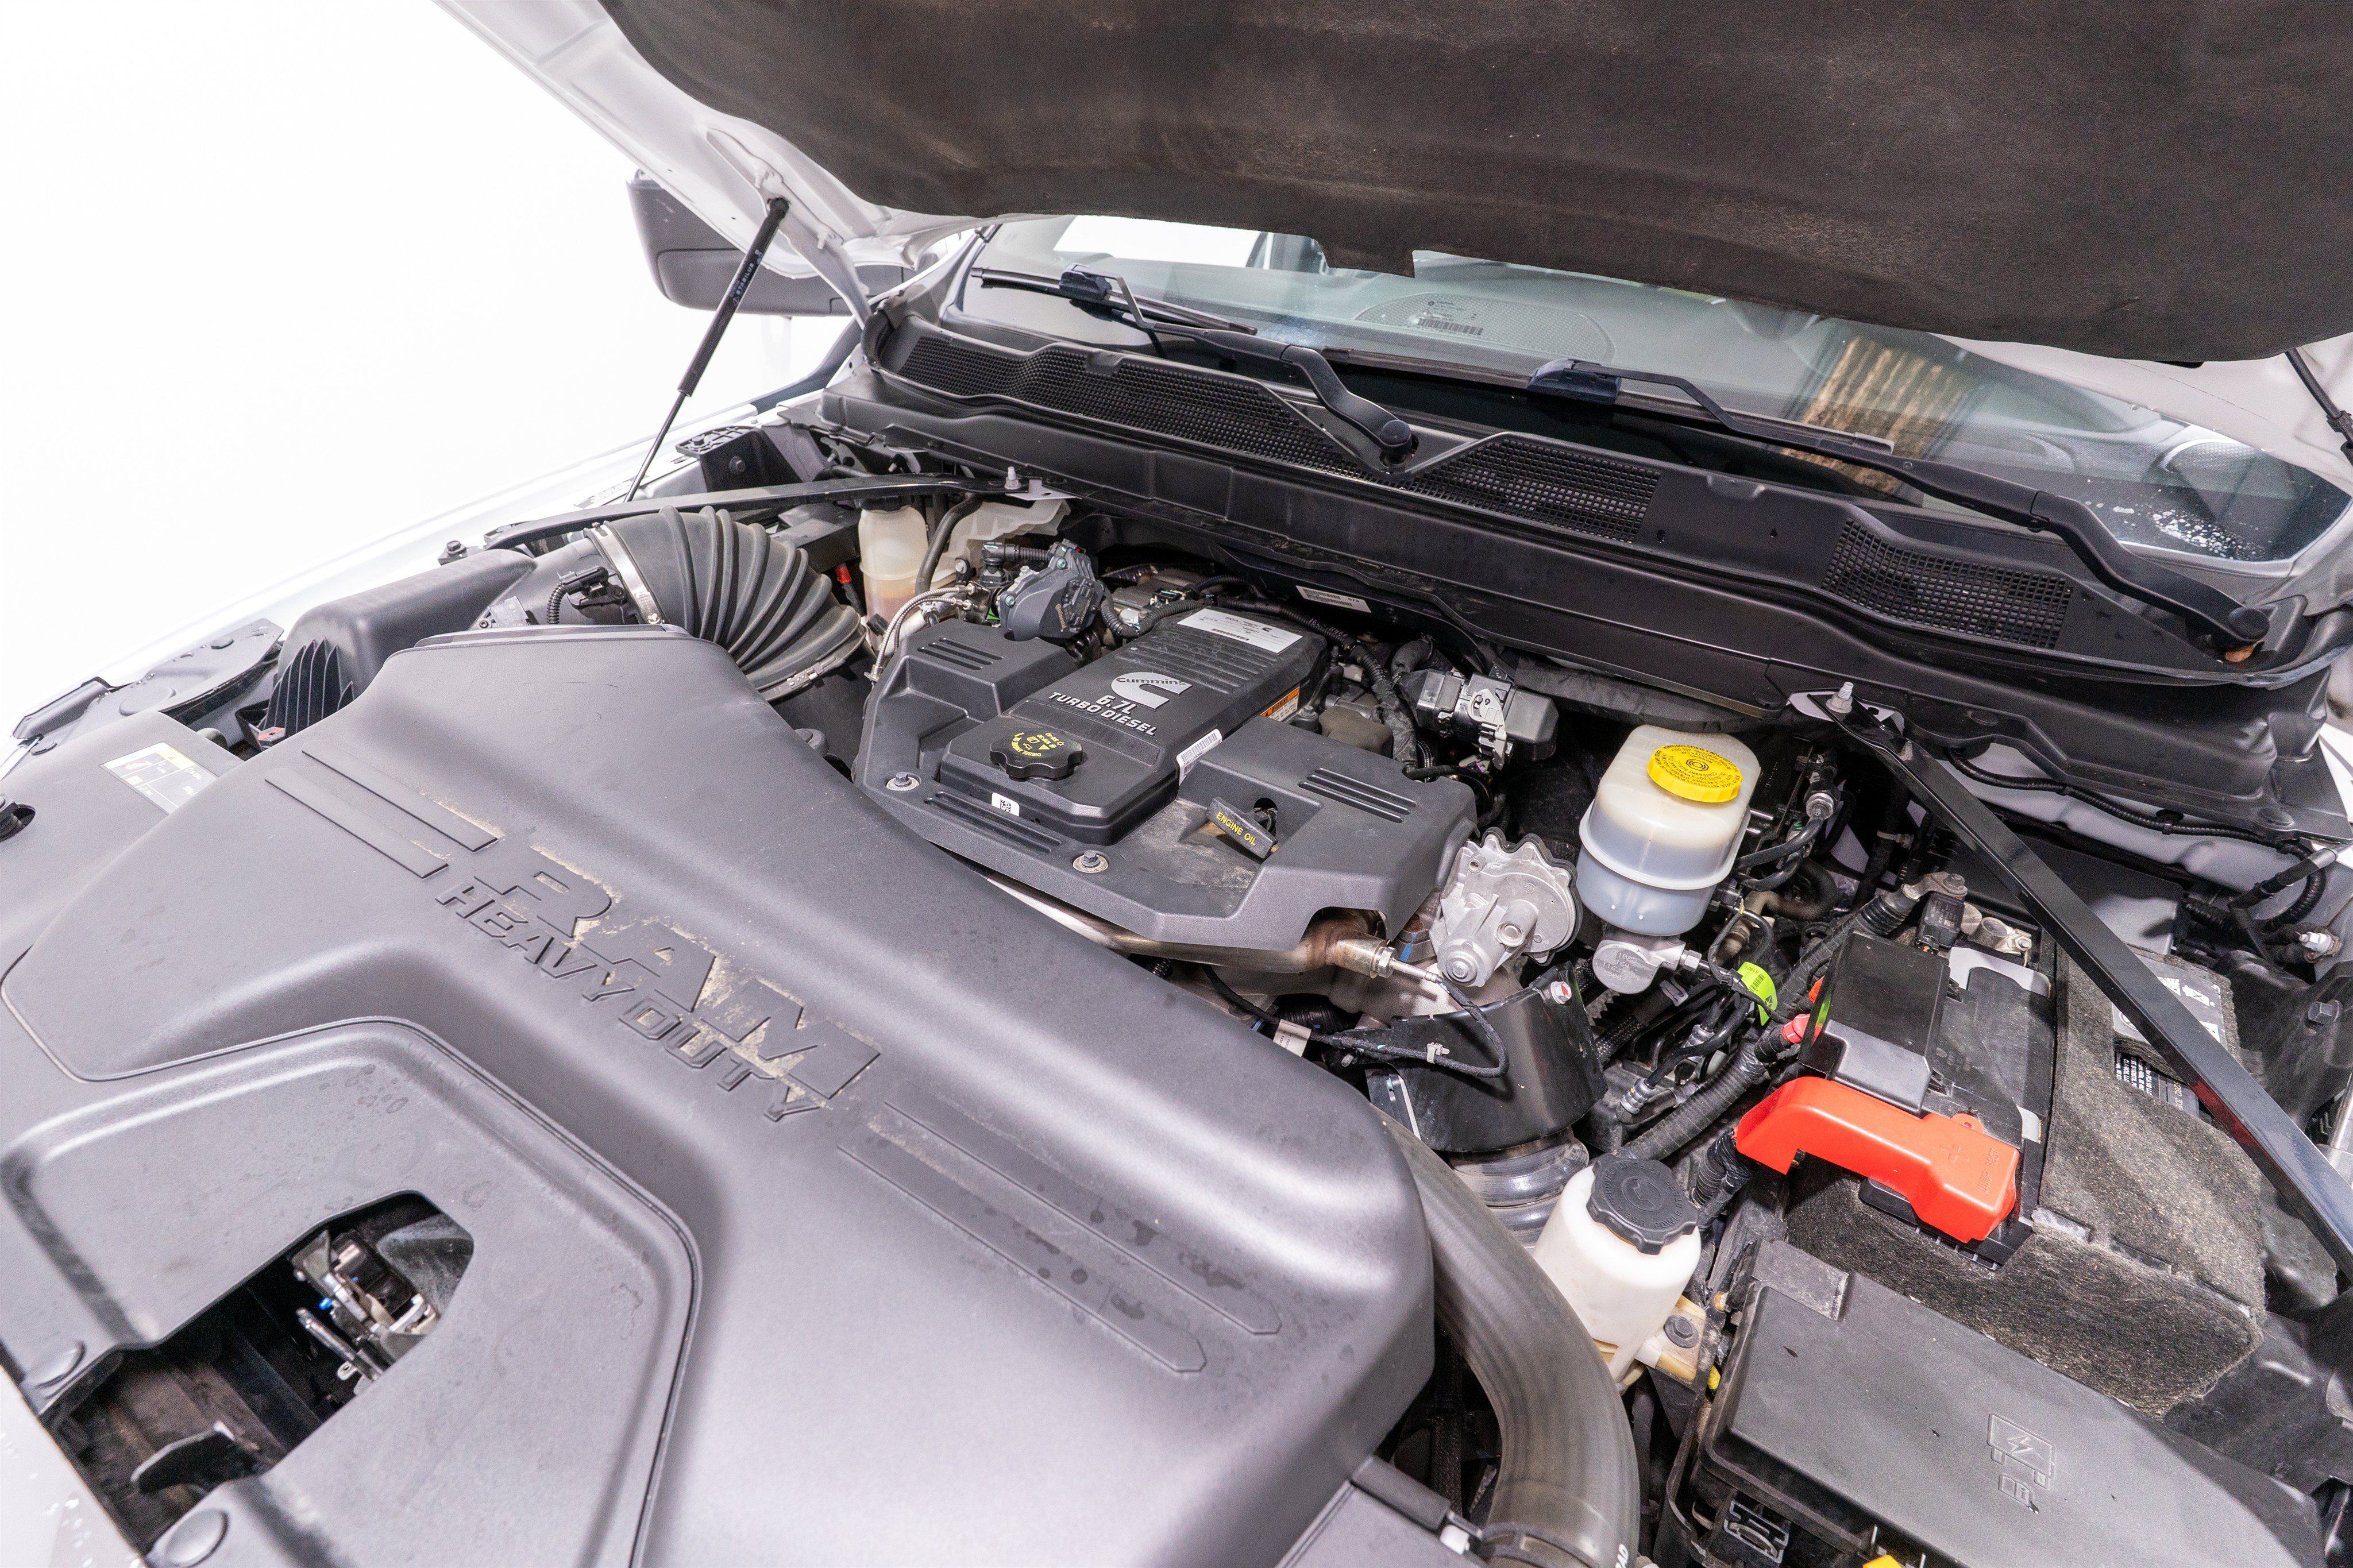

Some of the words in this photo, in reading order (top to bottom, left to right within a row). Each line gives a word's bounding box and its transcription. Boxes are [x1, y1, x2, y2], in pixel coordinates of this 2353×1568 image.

[1116, 677, 1186, 686] Cummins
[1048, 692, 1102, 713] TURBO
[1100, 709, 1158, 736] DIESEL
[1096, 694, 1137, 715] 6.7L
[1216, 812, 1244, 836] ENGINE
[1244, 833, 1257, 847] OIL
[474, 844, 881, 1100] RAM
[435, 879, 635, 1002] HEAVY
[619, 996, 821, 1122] DUTY
